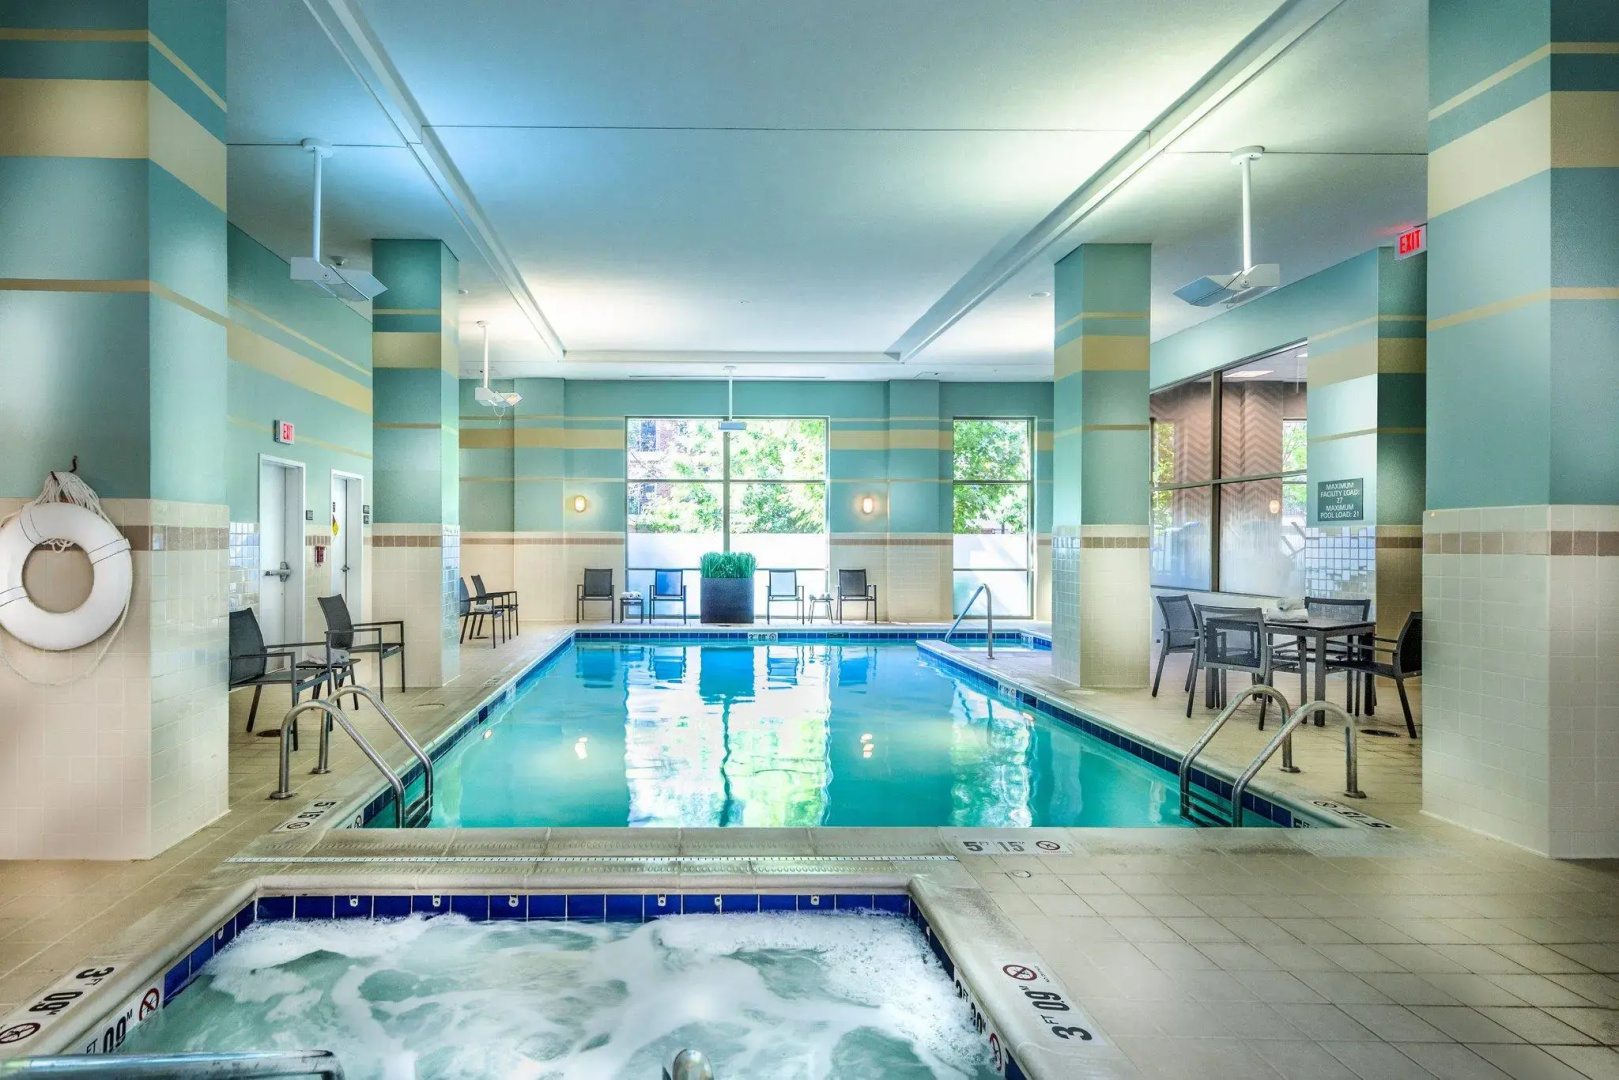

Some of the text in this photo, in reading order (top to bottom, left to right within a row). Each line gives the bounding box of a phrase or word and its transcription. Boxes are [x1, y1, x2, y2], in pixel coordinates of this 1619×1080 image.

[1399, 229, 1421, 254] EXIT
[282, 423, 293, 441] EXIT
[1325, 482, 1354, 490] MAXIMUM
[1320, 490, 1342, 498] FACILITY
[1325, 503, 1354, 512] MAXIMUM
[1320, 511, 1334, 519] POOL
[1051, 1026, 1092, 1041] 3
